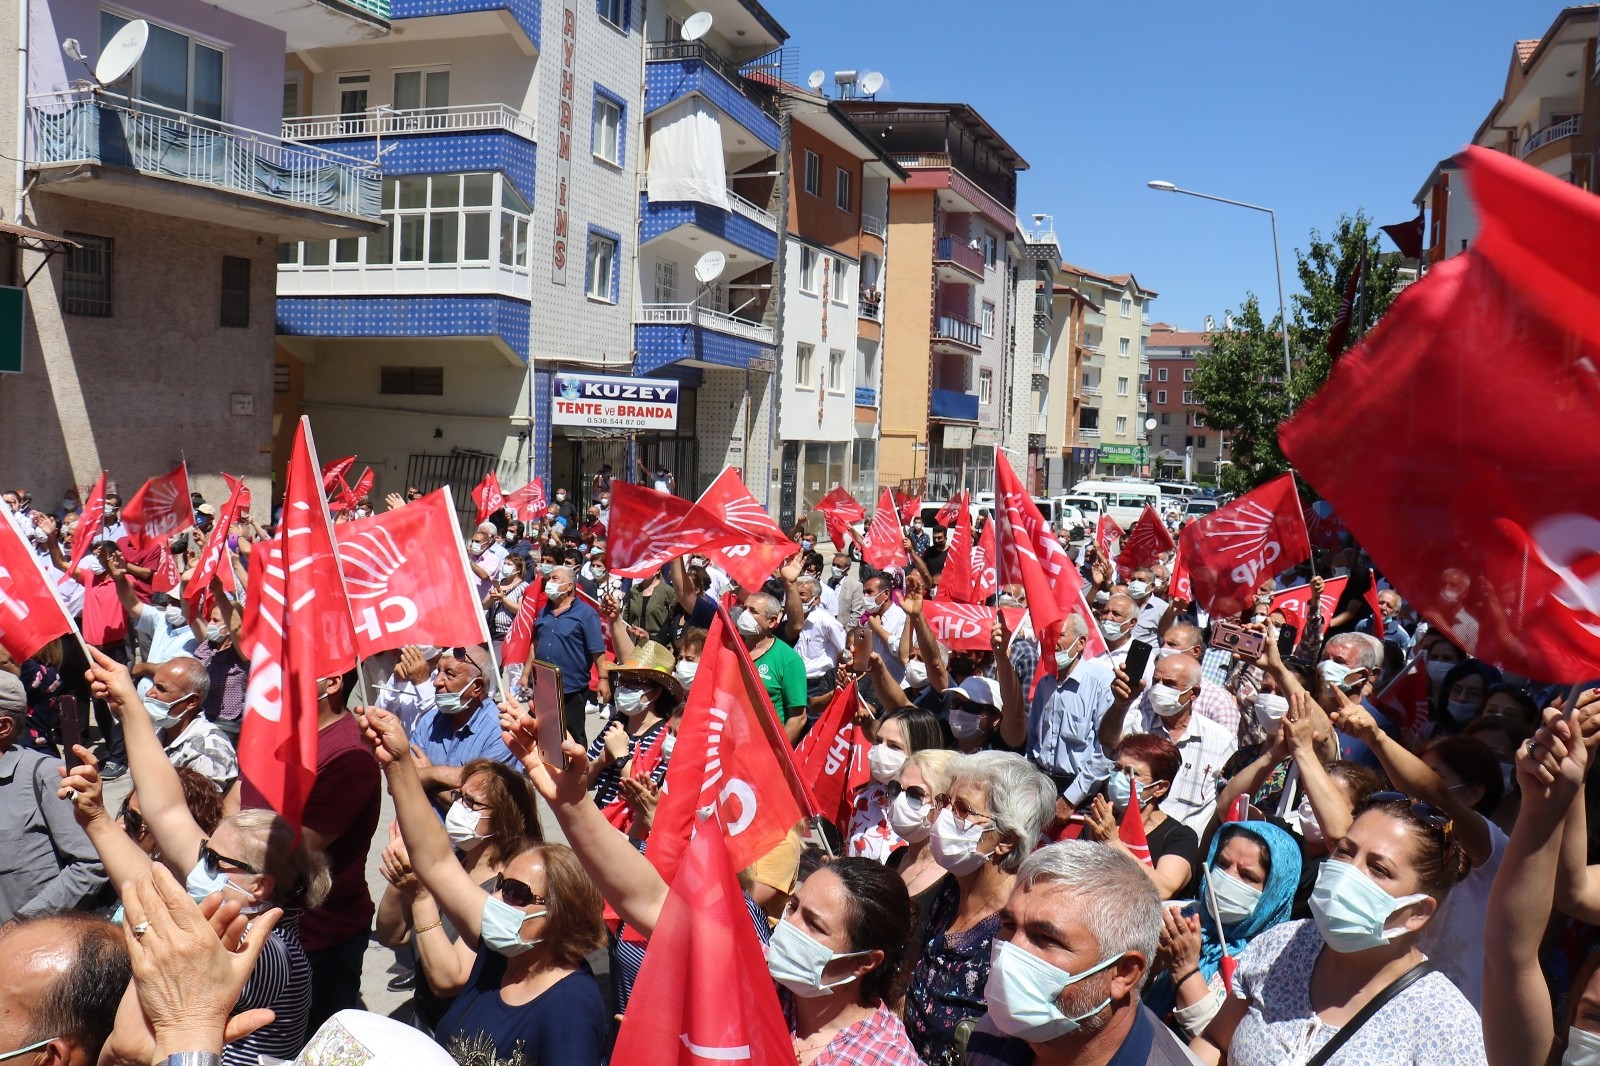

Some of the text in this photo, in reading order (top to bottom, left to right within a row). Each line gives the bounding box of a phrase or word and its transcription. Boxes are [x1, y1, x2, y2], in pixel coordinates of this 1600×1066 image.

[559, 8, 575, 161] AYHAN
[584, 382, 671, 400] KUZEY
[556, 401, 673, 419] TENTE ve BRANDA
[824, 722, 853, 776] CHP
